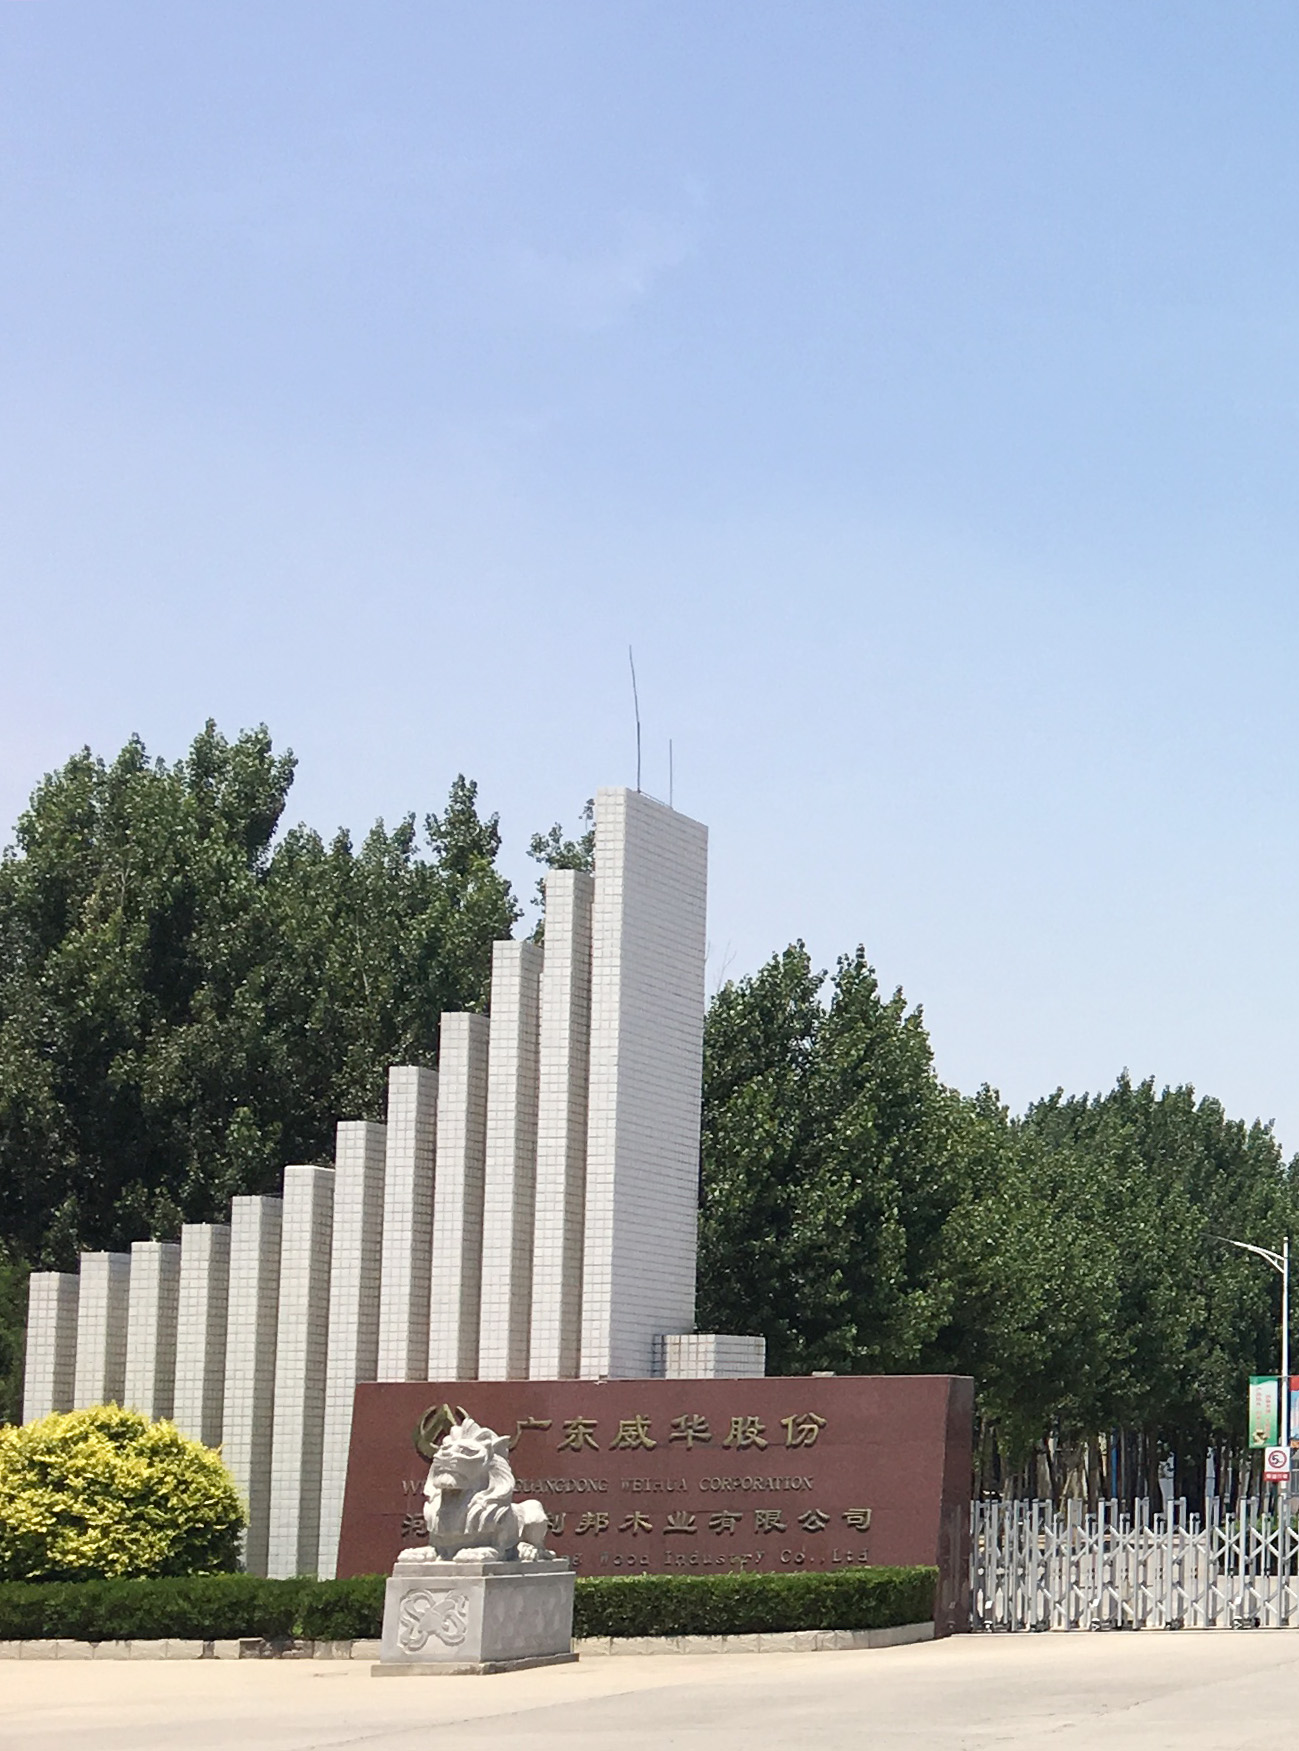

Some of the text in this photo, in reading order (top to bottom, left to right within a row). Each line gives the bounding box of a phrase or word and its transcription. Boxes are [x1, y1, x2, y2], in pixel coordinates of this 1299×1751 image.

[509, 1412, 828, 1452] 广东威华股份
[700, 1476, 814, 1493] CORPORATION
